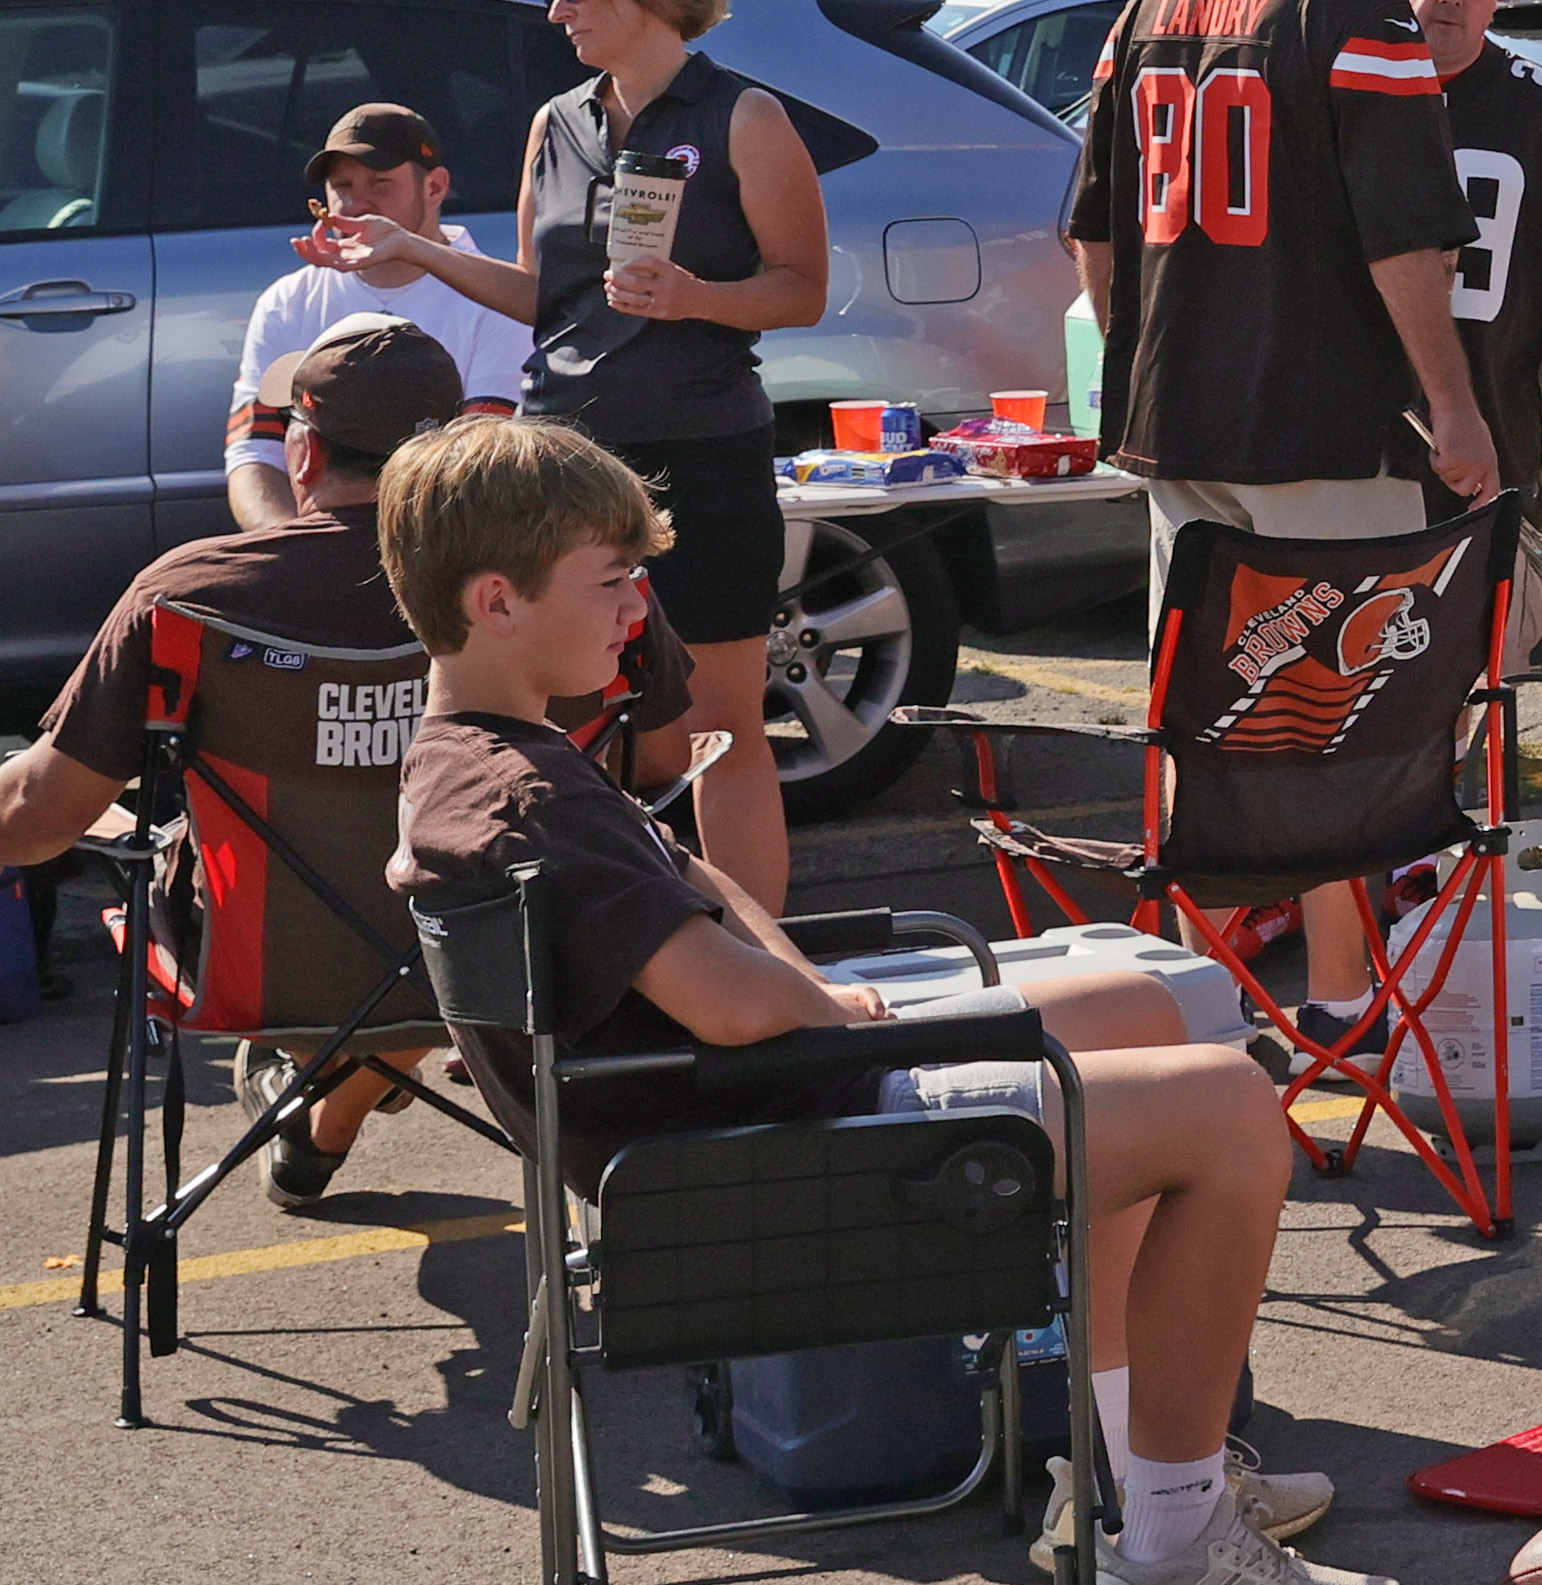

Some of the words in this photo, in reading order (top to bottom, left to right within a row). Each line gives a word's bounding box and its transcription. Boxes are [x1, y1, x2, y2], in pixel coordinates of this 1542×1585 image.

[1131, 67, 1272, 246] 80
[1228, 581, 1344, 686] BROWNS
[1237, 589, 1305, 646] CLEVELAND
[318, 679, 429, 720] CLEVEL
[316, 716, 420, 766] BROW
